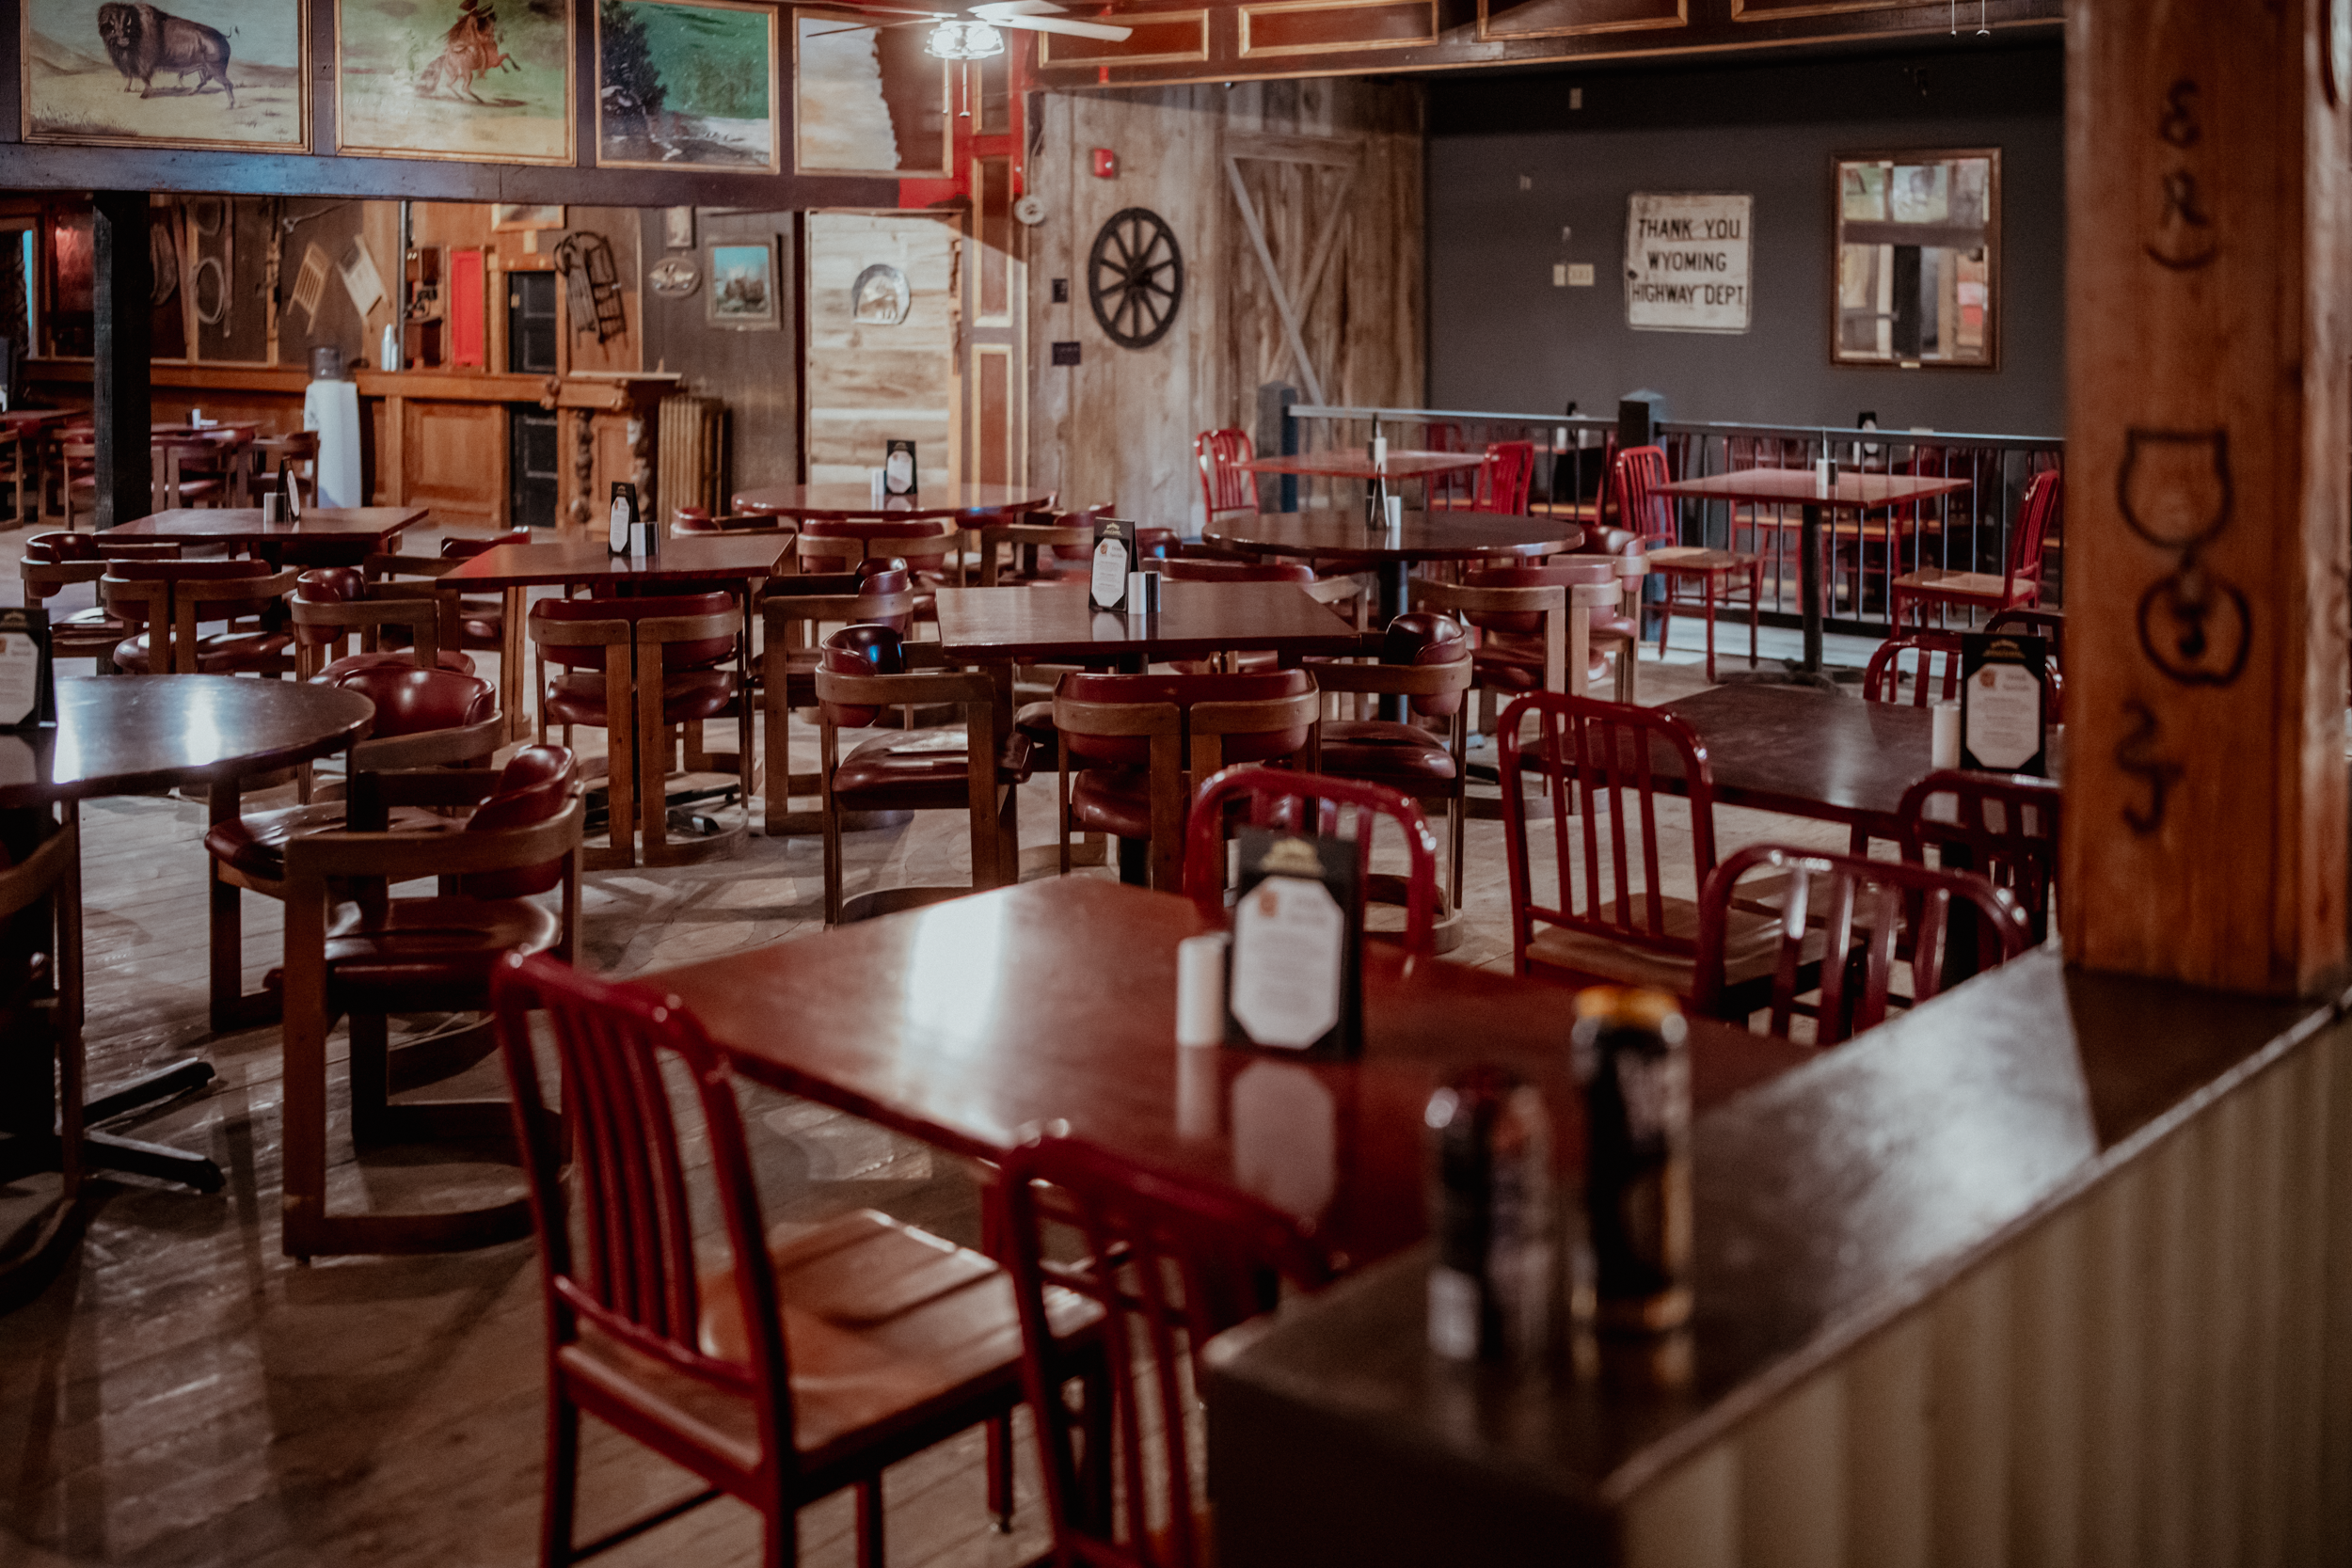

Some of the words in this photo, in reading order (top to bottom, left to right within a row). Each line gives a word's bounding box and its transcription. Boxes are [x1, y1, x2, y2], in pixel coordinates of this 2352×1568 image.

[1639, 218, 1693, 240] THANK
[1705, 218, 1740, 239] YOU
[1647, 251, 1726, 271] WYOMING
[1631, 284, 1694, 303] HIGHWAY
[1705, 283, 1744, 306] DEPT
